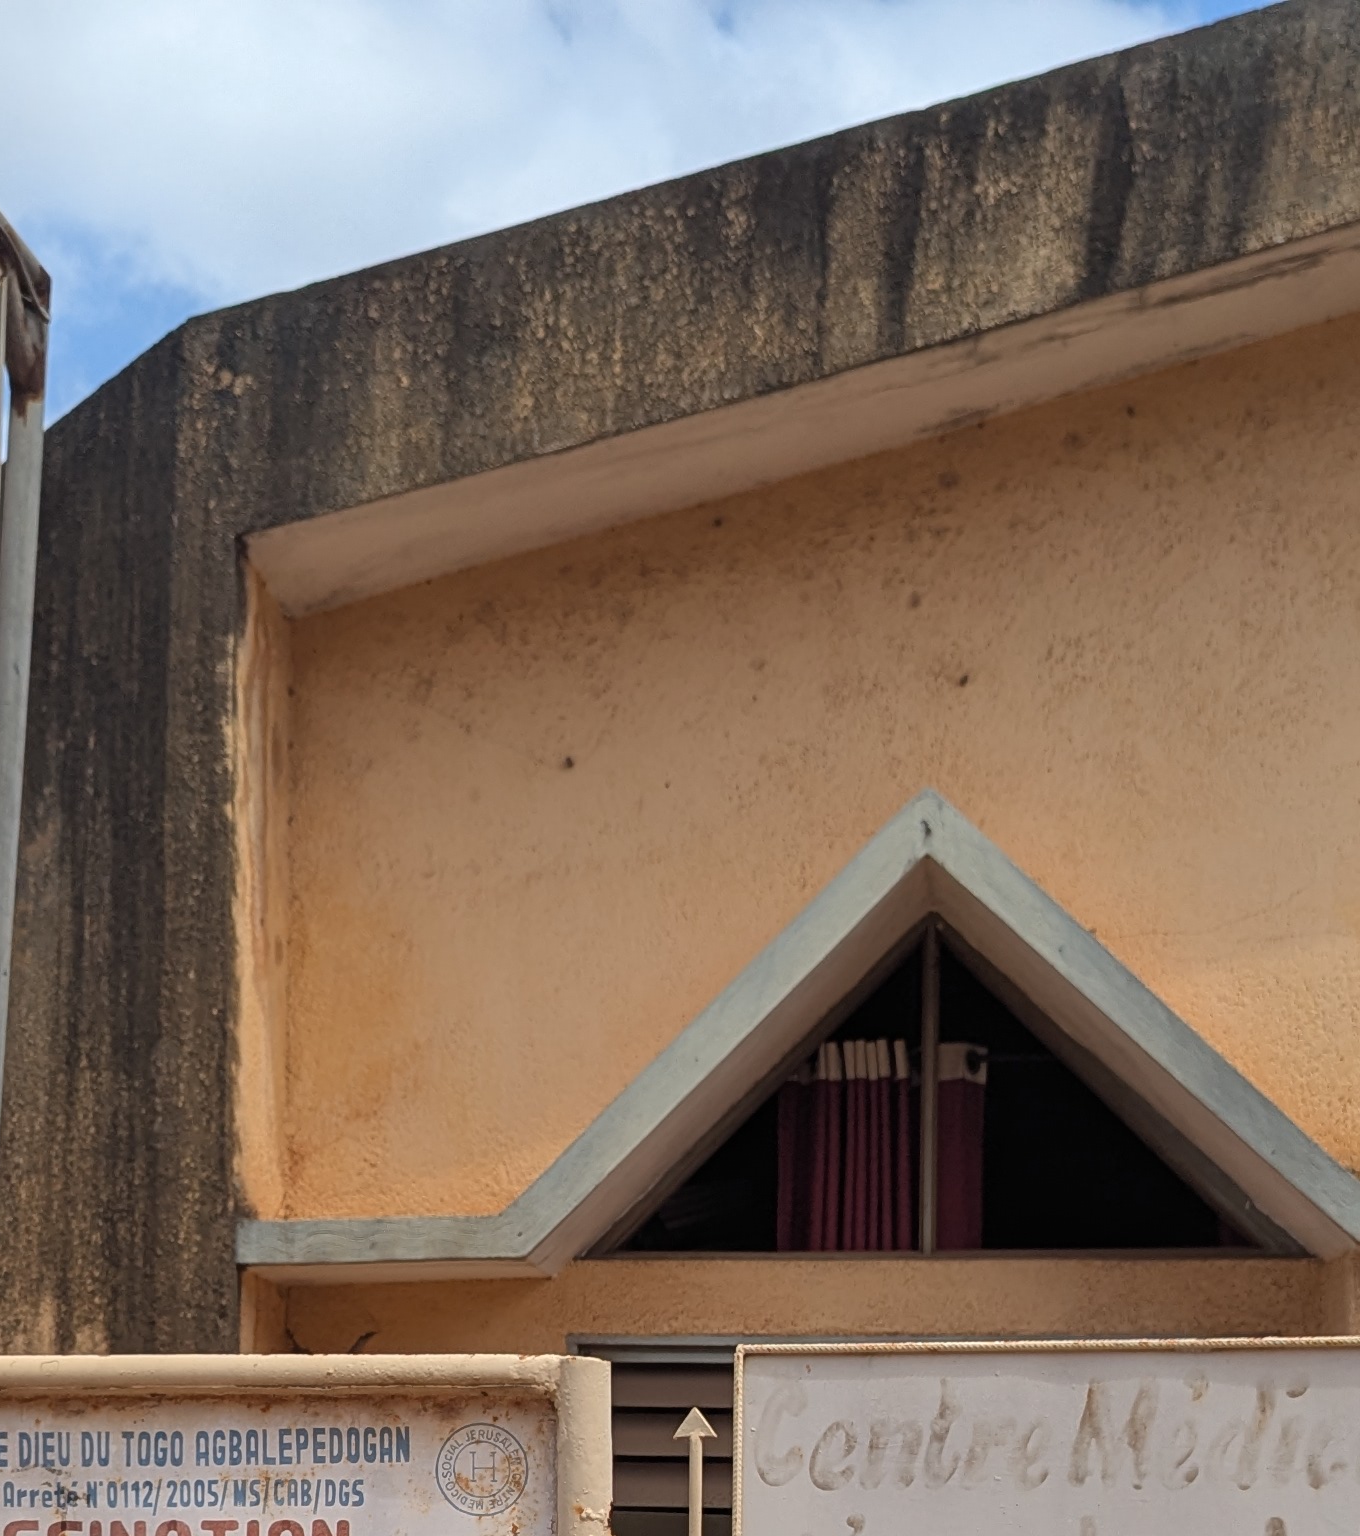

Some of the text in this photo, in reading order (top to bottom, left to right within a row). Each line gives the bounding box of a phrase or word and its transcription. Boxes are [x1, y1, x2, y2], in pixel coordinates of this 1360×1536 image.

[18, 1431, 71, 1468] DIEU
[81, 1430, 111, 1467] DU
[121, 1430, 184, 1467] TOGO
[195, 1425, 411, 1467] AGBALEPEDOGAN
[3, 1481, 79, 1509] Arrêté
